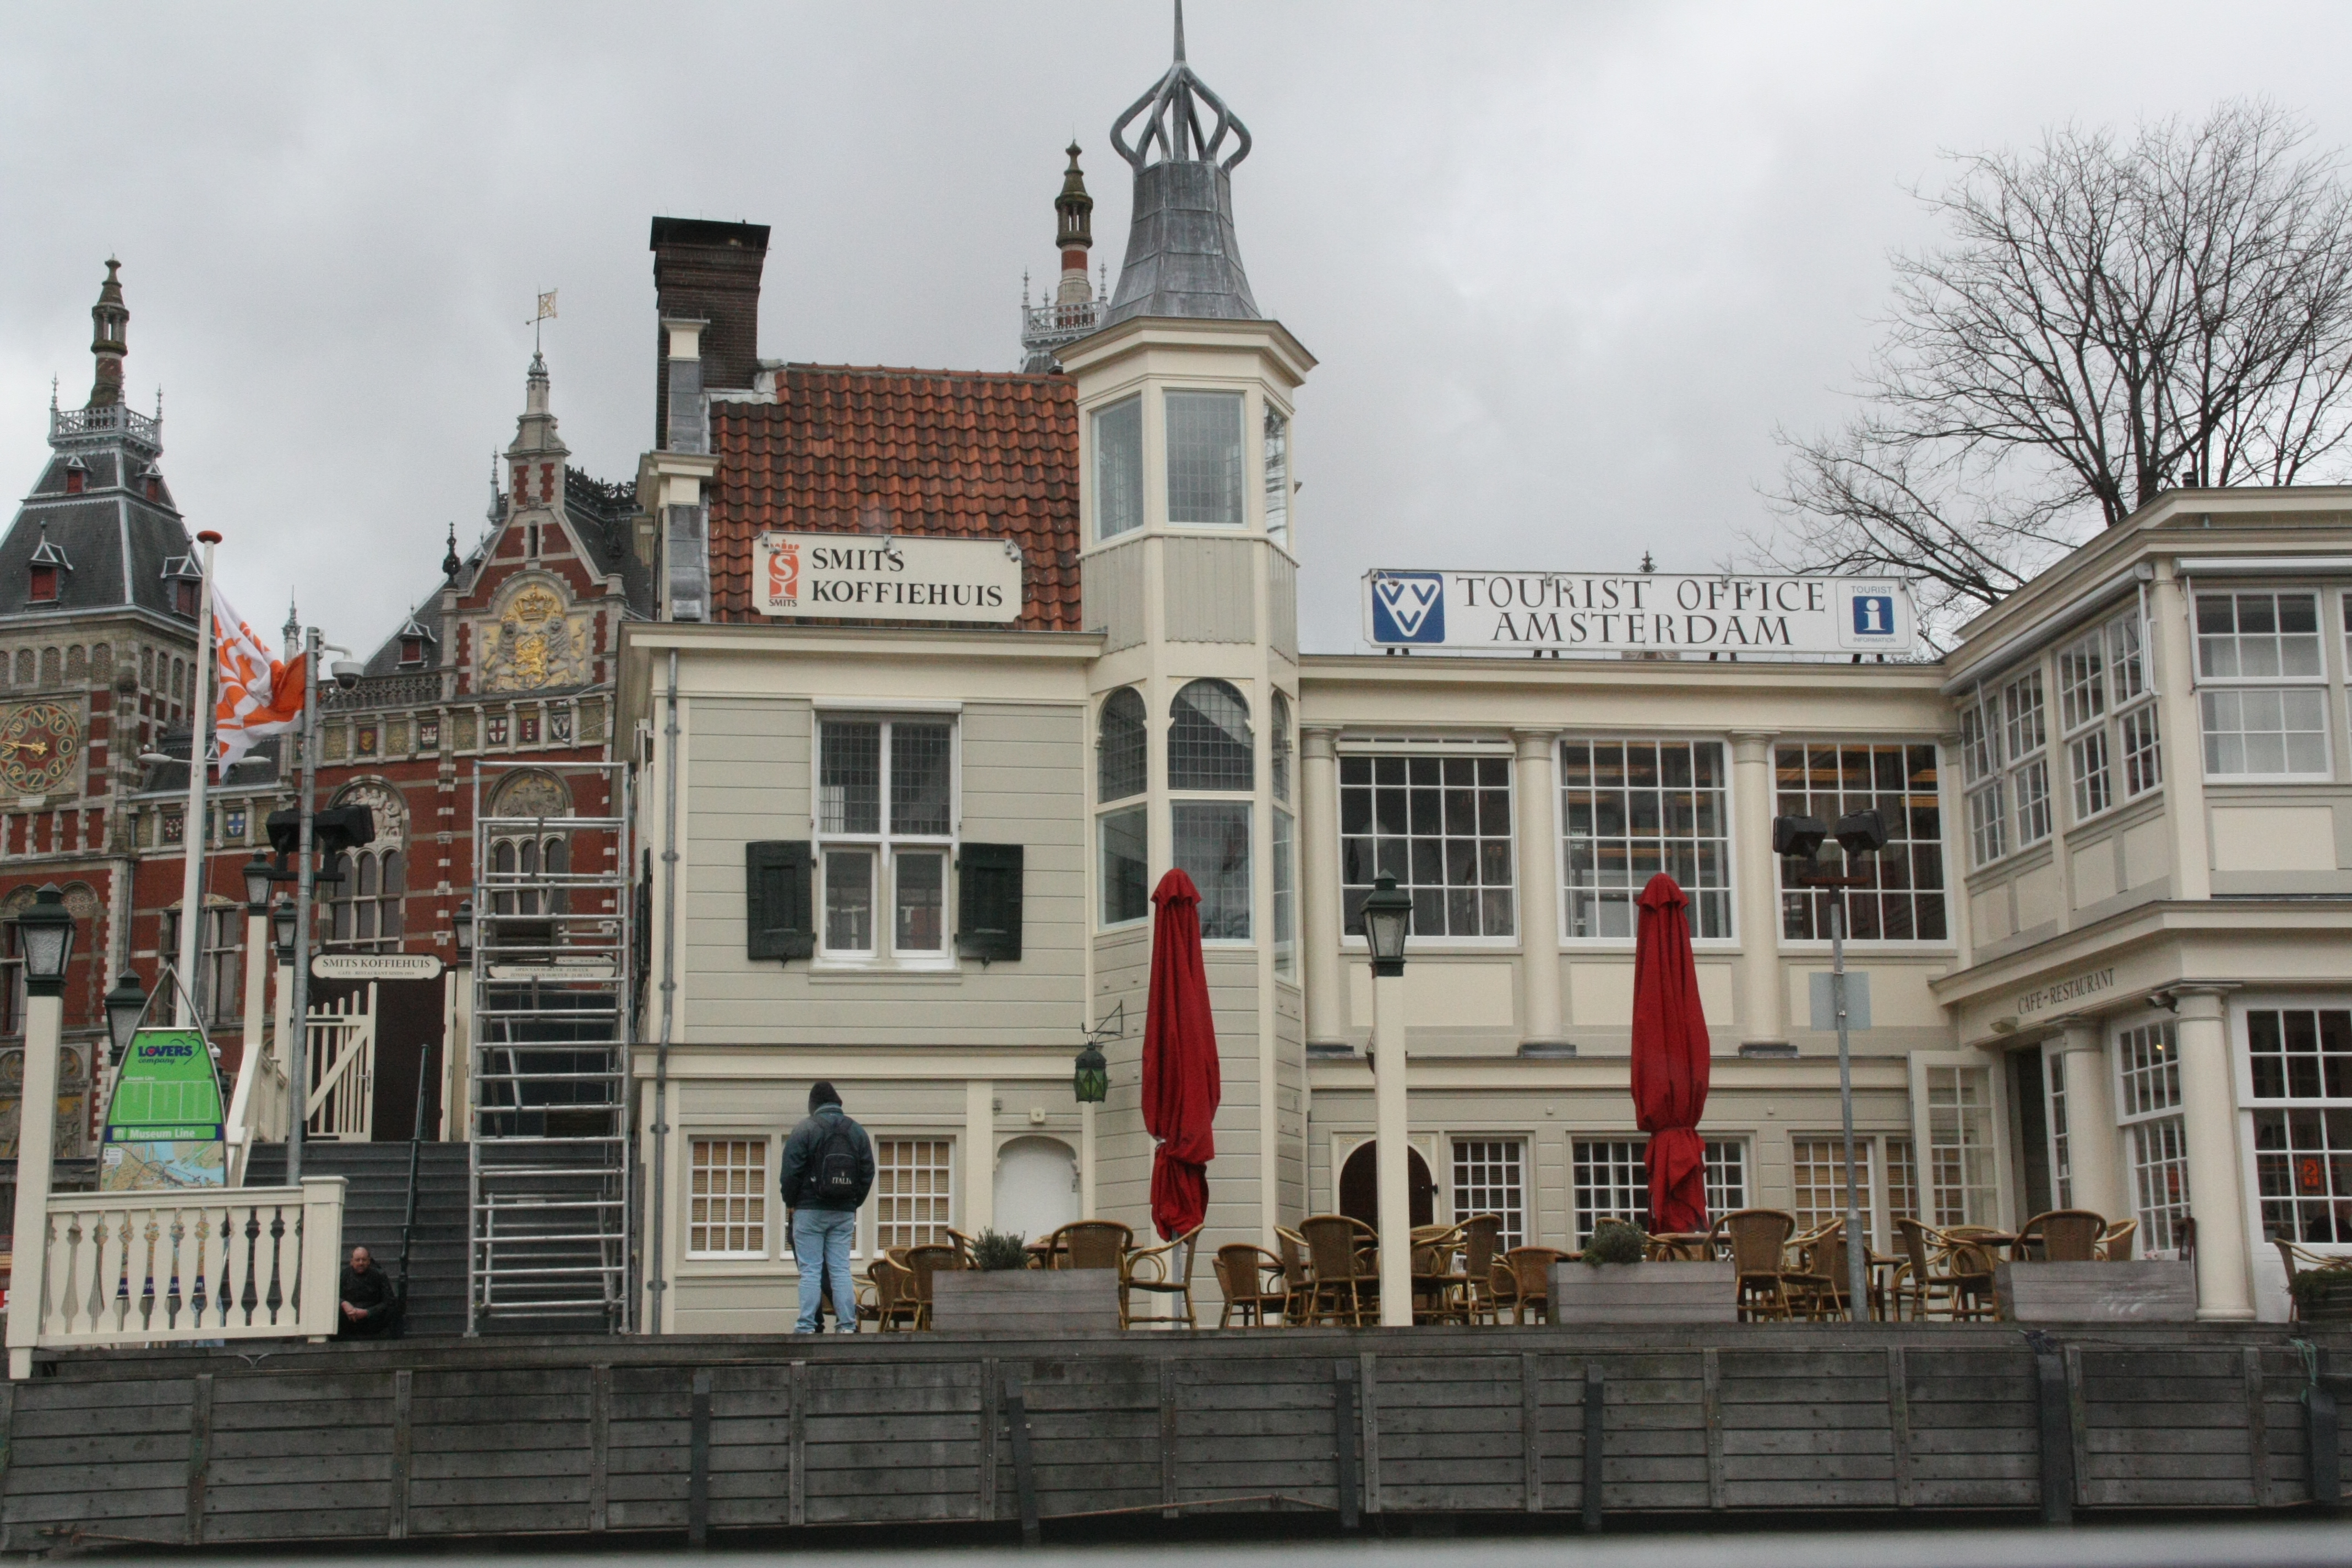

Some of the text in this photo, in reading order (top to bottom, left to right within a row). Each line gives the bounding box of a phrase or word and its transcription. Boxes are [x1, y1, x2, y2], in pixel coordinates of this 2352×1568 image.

[812, 547, 905, 572] SMITS
[769, 598, 798, 607] SMITS
[812, 580, 1003, 607] KOFFIEHUIS
[1456, 575, 1826, 613] TOURIST OFFICE
[1491, 611, 1793, 646] AMSTERDAM
[323, 959, 431, 968] SMITS KOFFIEHUIS
[138, 1046, 193, 1058] LOVERS
[130, 1128, 195, 1138] Museum Line
